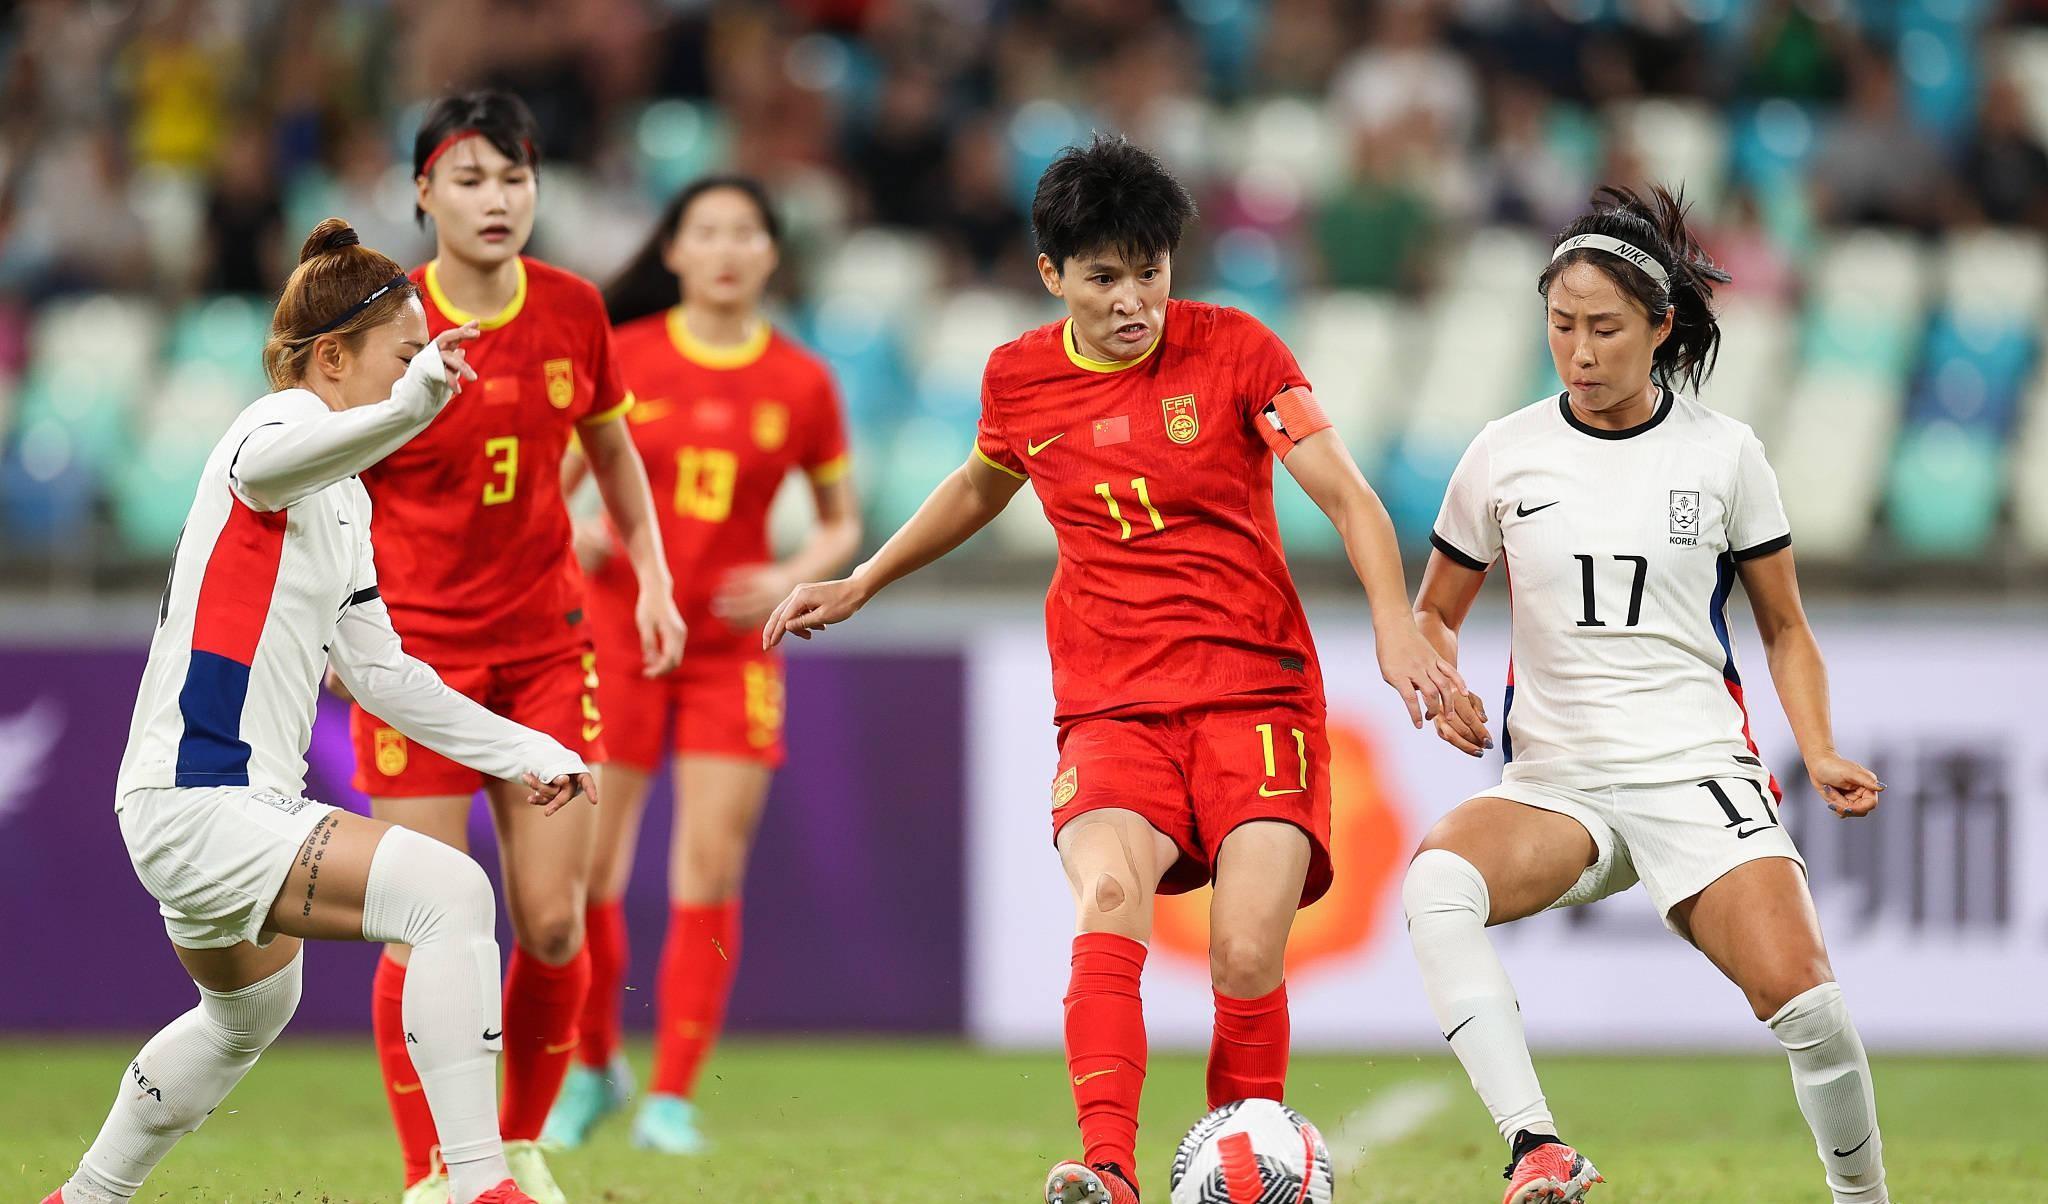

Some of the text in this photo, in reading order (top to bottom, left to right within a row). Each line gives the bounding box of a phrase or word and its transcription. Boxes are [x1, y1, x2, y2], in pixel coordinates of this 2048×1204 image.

[1614, 243, 1652, 267] NIKE
[1165, 398, 1192, 411] CFA
[482, 435, 519, 506] 3
[674, 446, 738, 524] 13
[1094, 476, 1166, 540] 11
[1669, 536, 1698, 546] KOREA
[1573, 554, 1648, 627] 17
[1255, 723, 1308, 790] 11
[132, 1061, 161, 1102] REA
